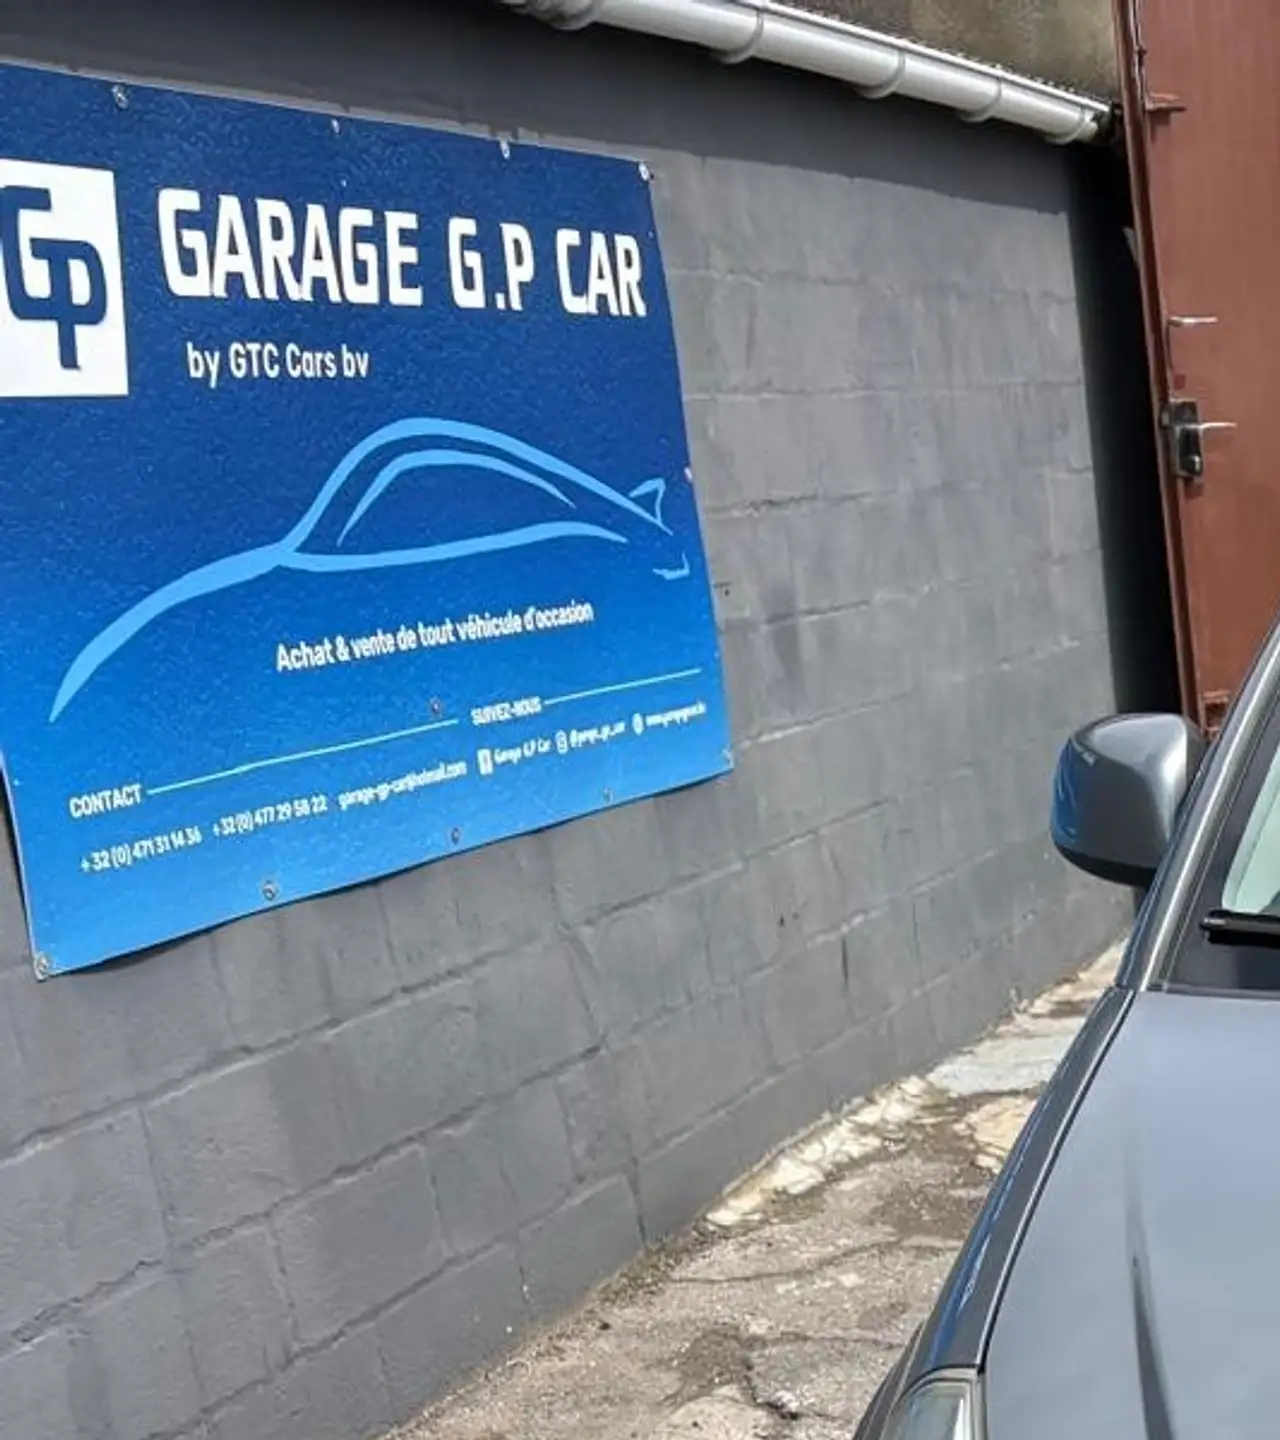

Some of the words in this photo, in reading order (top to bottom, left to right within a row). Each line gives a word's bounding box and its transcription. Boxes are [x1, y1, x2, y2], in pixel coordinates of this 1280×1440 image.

[0, 185, 108, 371] GP
[158, 188, 424, 307] GARAGE
[448, 217, 535, 312] G.P
[556, 228, 648, 318] CAR
[187, 341, 220, 388] by
[228, 342, 280, 378] GTC
[286, 342, 338, 378] Cars
[341, 344, 369, 378] bv
[276, 637, 335, 672] Achat
[335, 635, 350, 662] &
[350, 628, 395, 658] vente
[396, 624, 417, 651] de
[418, 618, 456, 648] tout
[456, 609, 522, 641] véhicule
[523, 600, 594, 632] d'occasion
[69, 783, 143, 819] CONTACT
